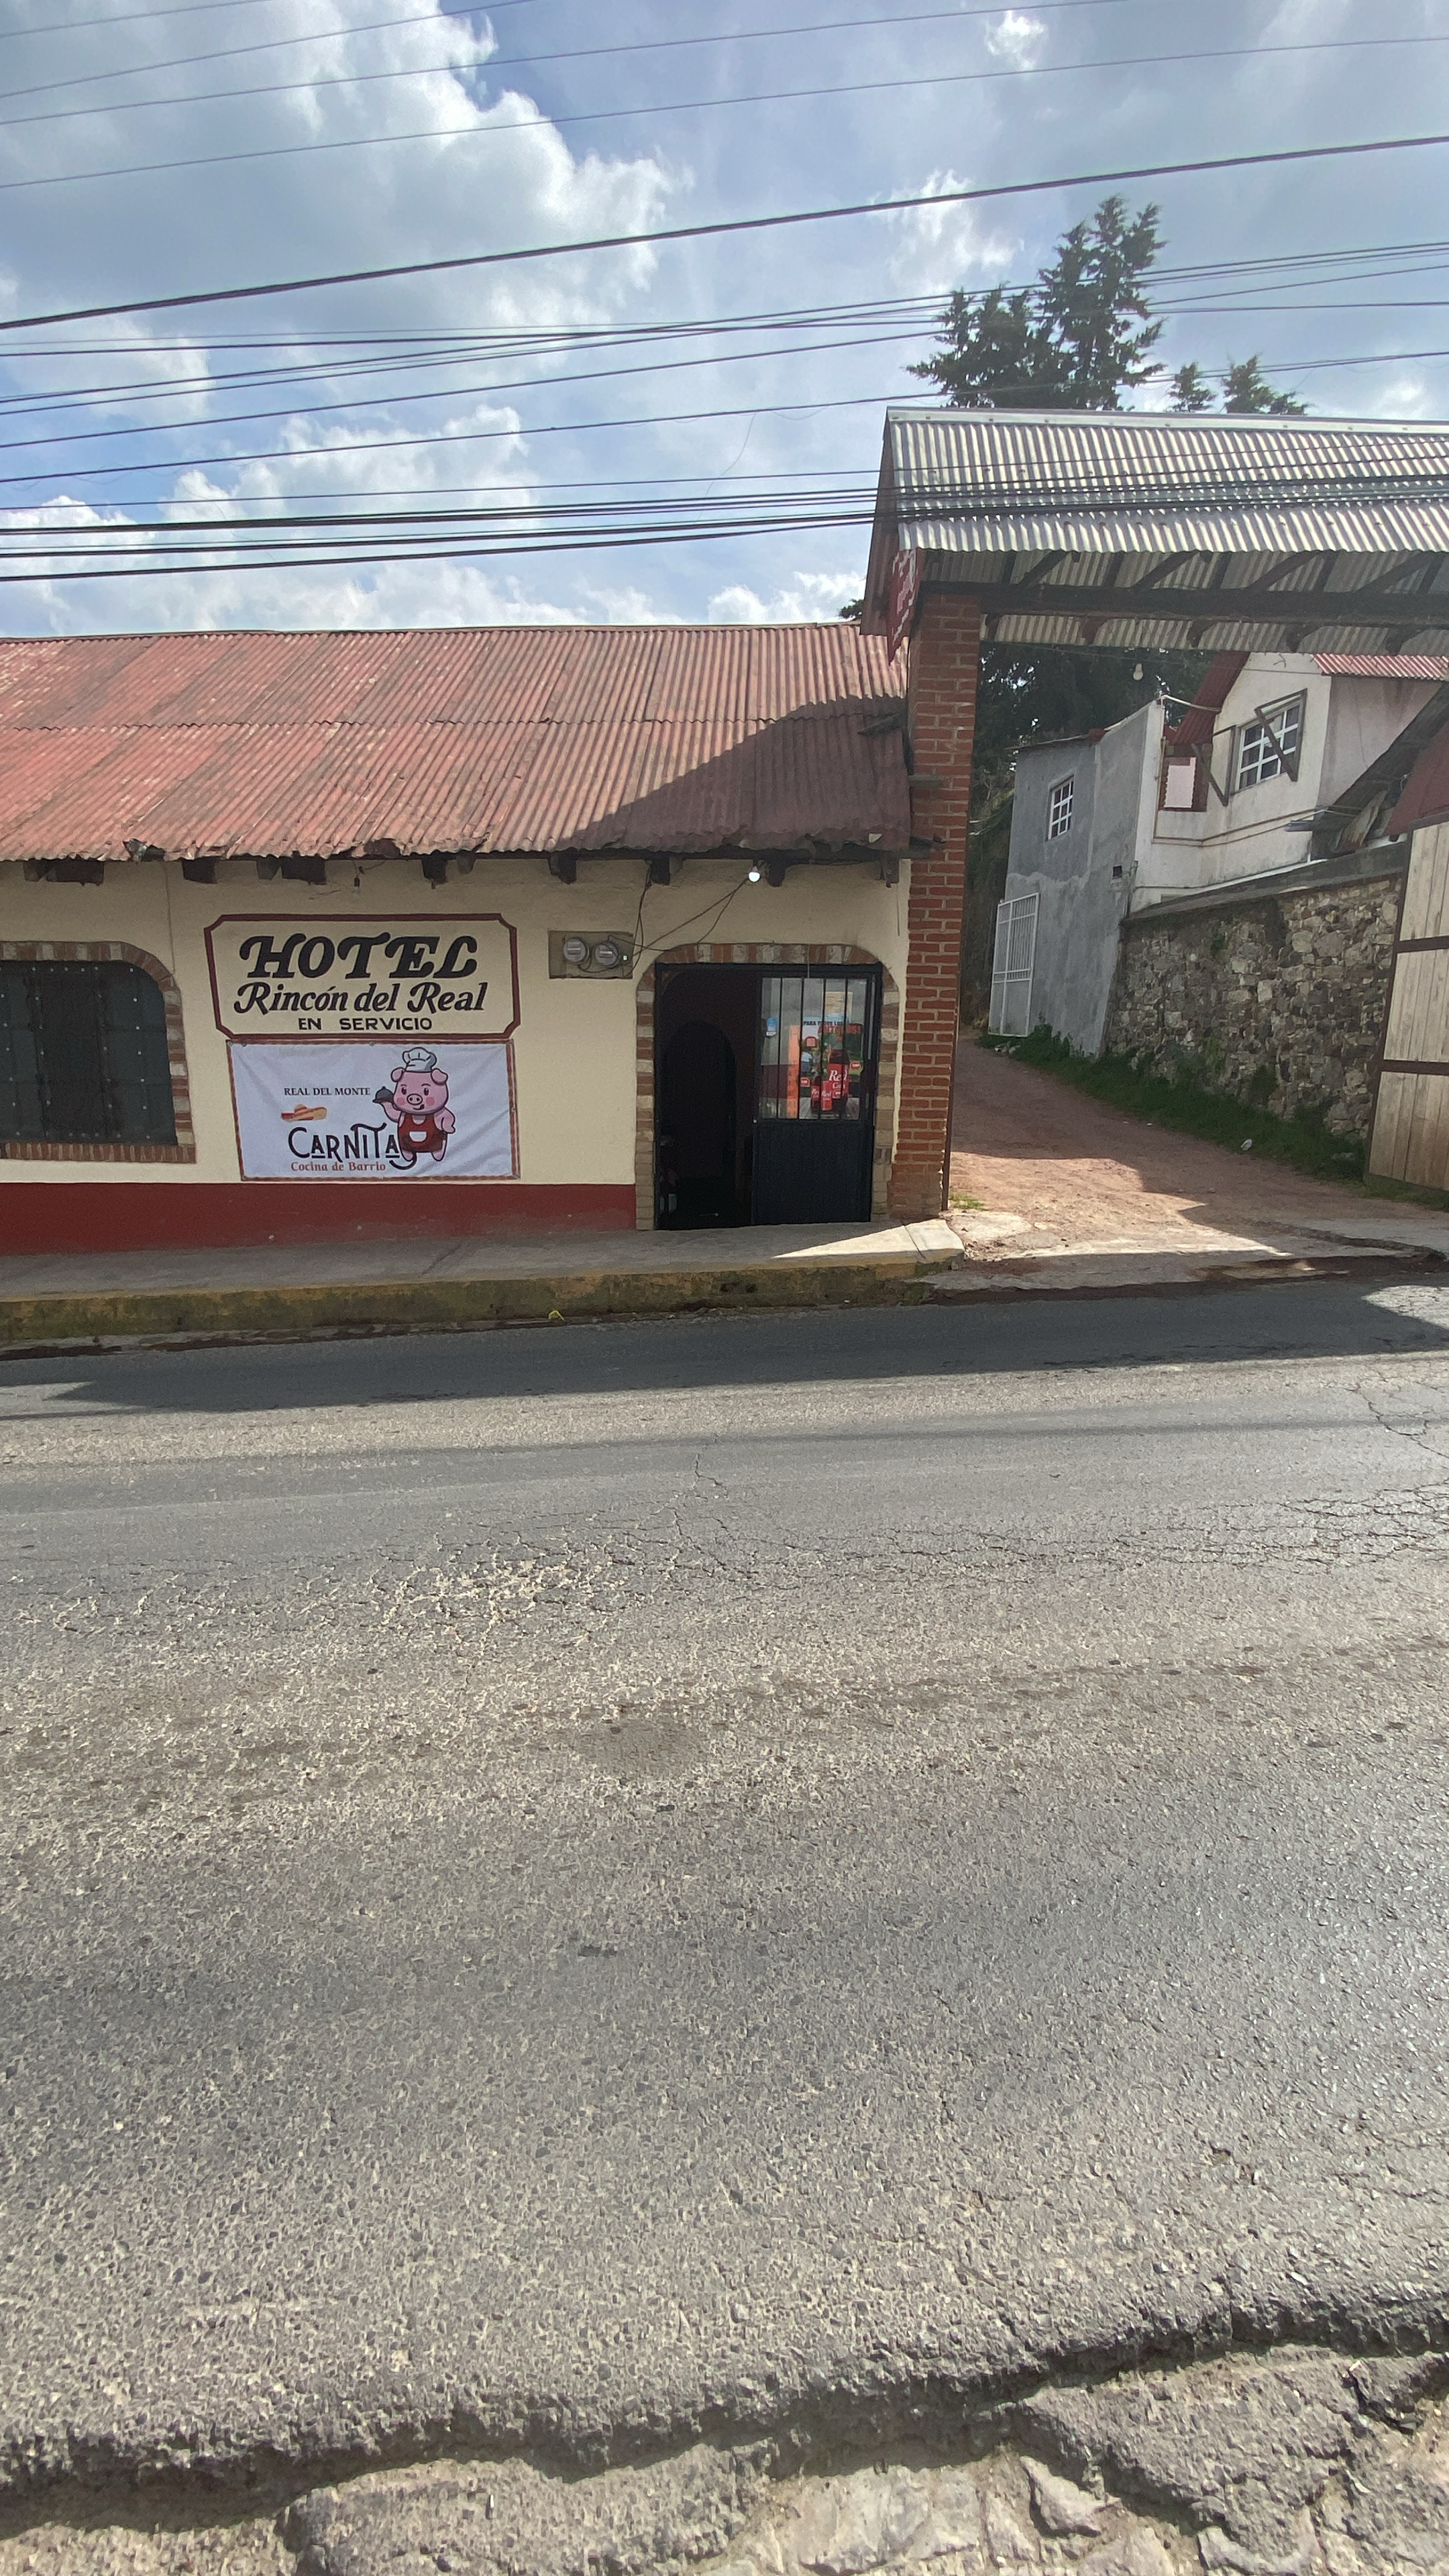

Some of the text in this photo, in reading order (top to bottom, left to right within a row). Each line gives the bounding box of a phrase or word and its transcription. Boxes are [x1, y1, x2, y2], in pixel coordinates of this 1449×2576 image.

[239, 932, 478, 979] HOTEL
[233, 981, 488, 1015] Rincón del Real
[299, 1018, 433, 1030] EN SERVICIO
[284, 1087, 370, 1095] REAL DEL MONTE
[290, 1161, 386, 1171] Cocina de Barrio
